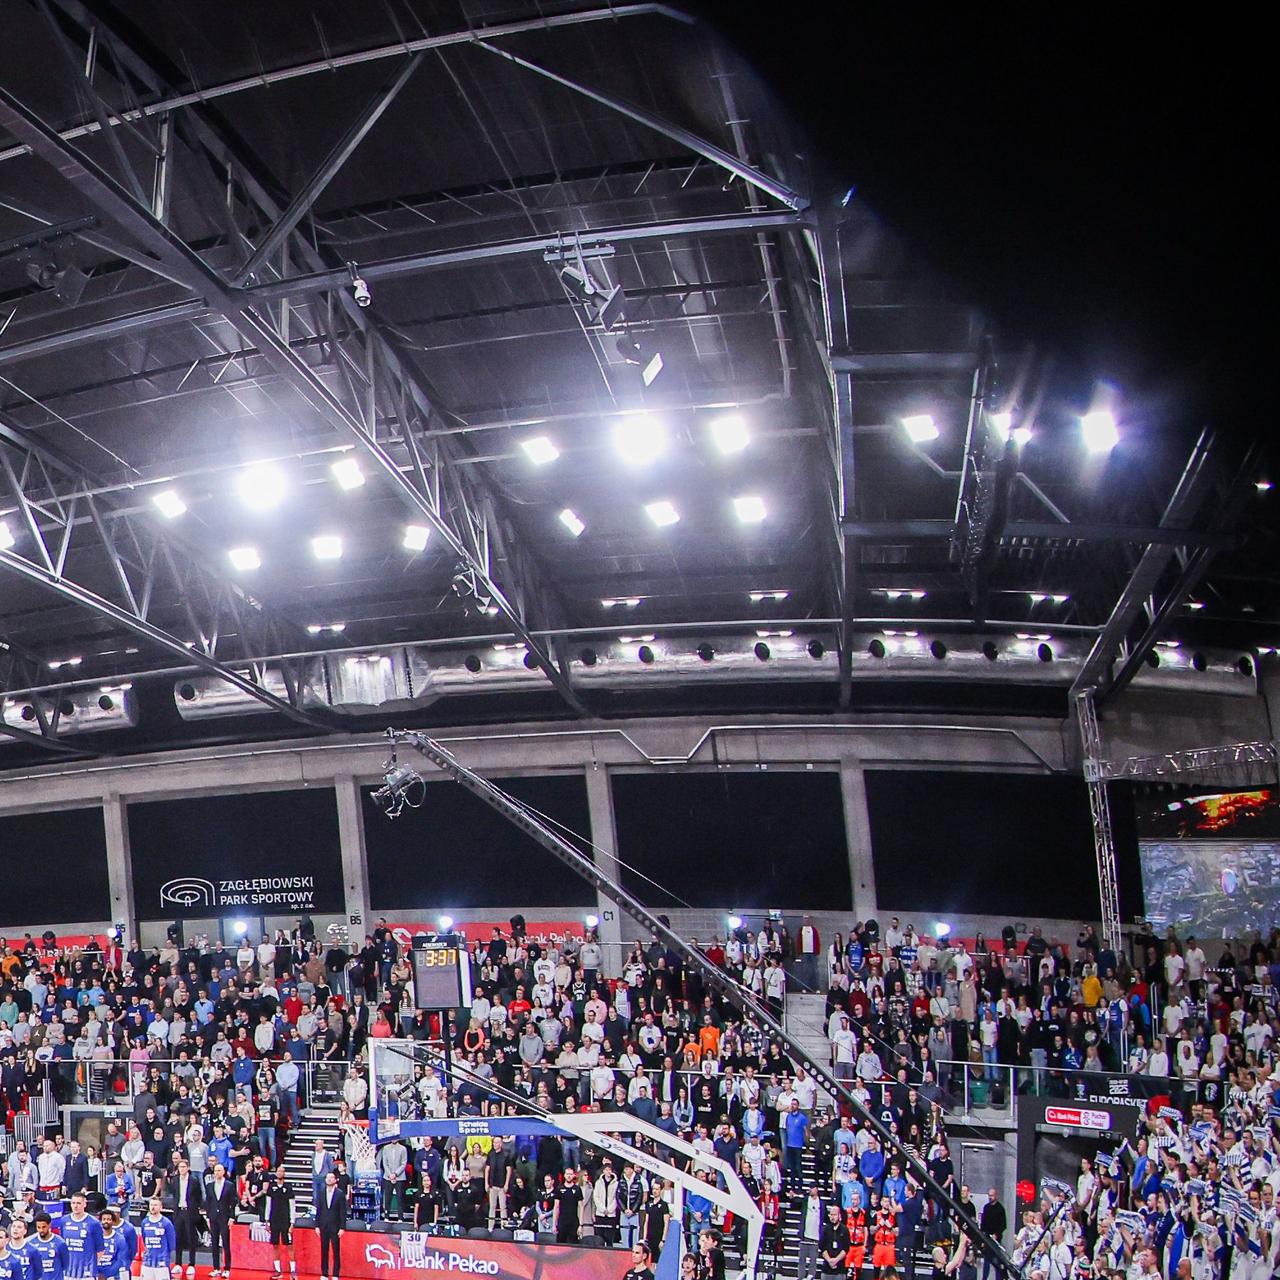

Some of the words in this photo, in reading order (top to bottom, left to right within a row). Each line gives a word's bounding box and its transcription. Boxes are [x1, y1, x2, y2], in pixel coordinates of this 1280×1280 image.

[220, 877, 314, 893] ZAGŁĘBIOWSKI
[220, 894, 248, 906] PARK
[251, 892, 314, 905] SPORTOWY
[603, 912, 614, 921] C1
[407, 1233, 421, 1242] 30
[448, 1253, 499, 1275] Pekao
